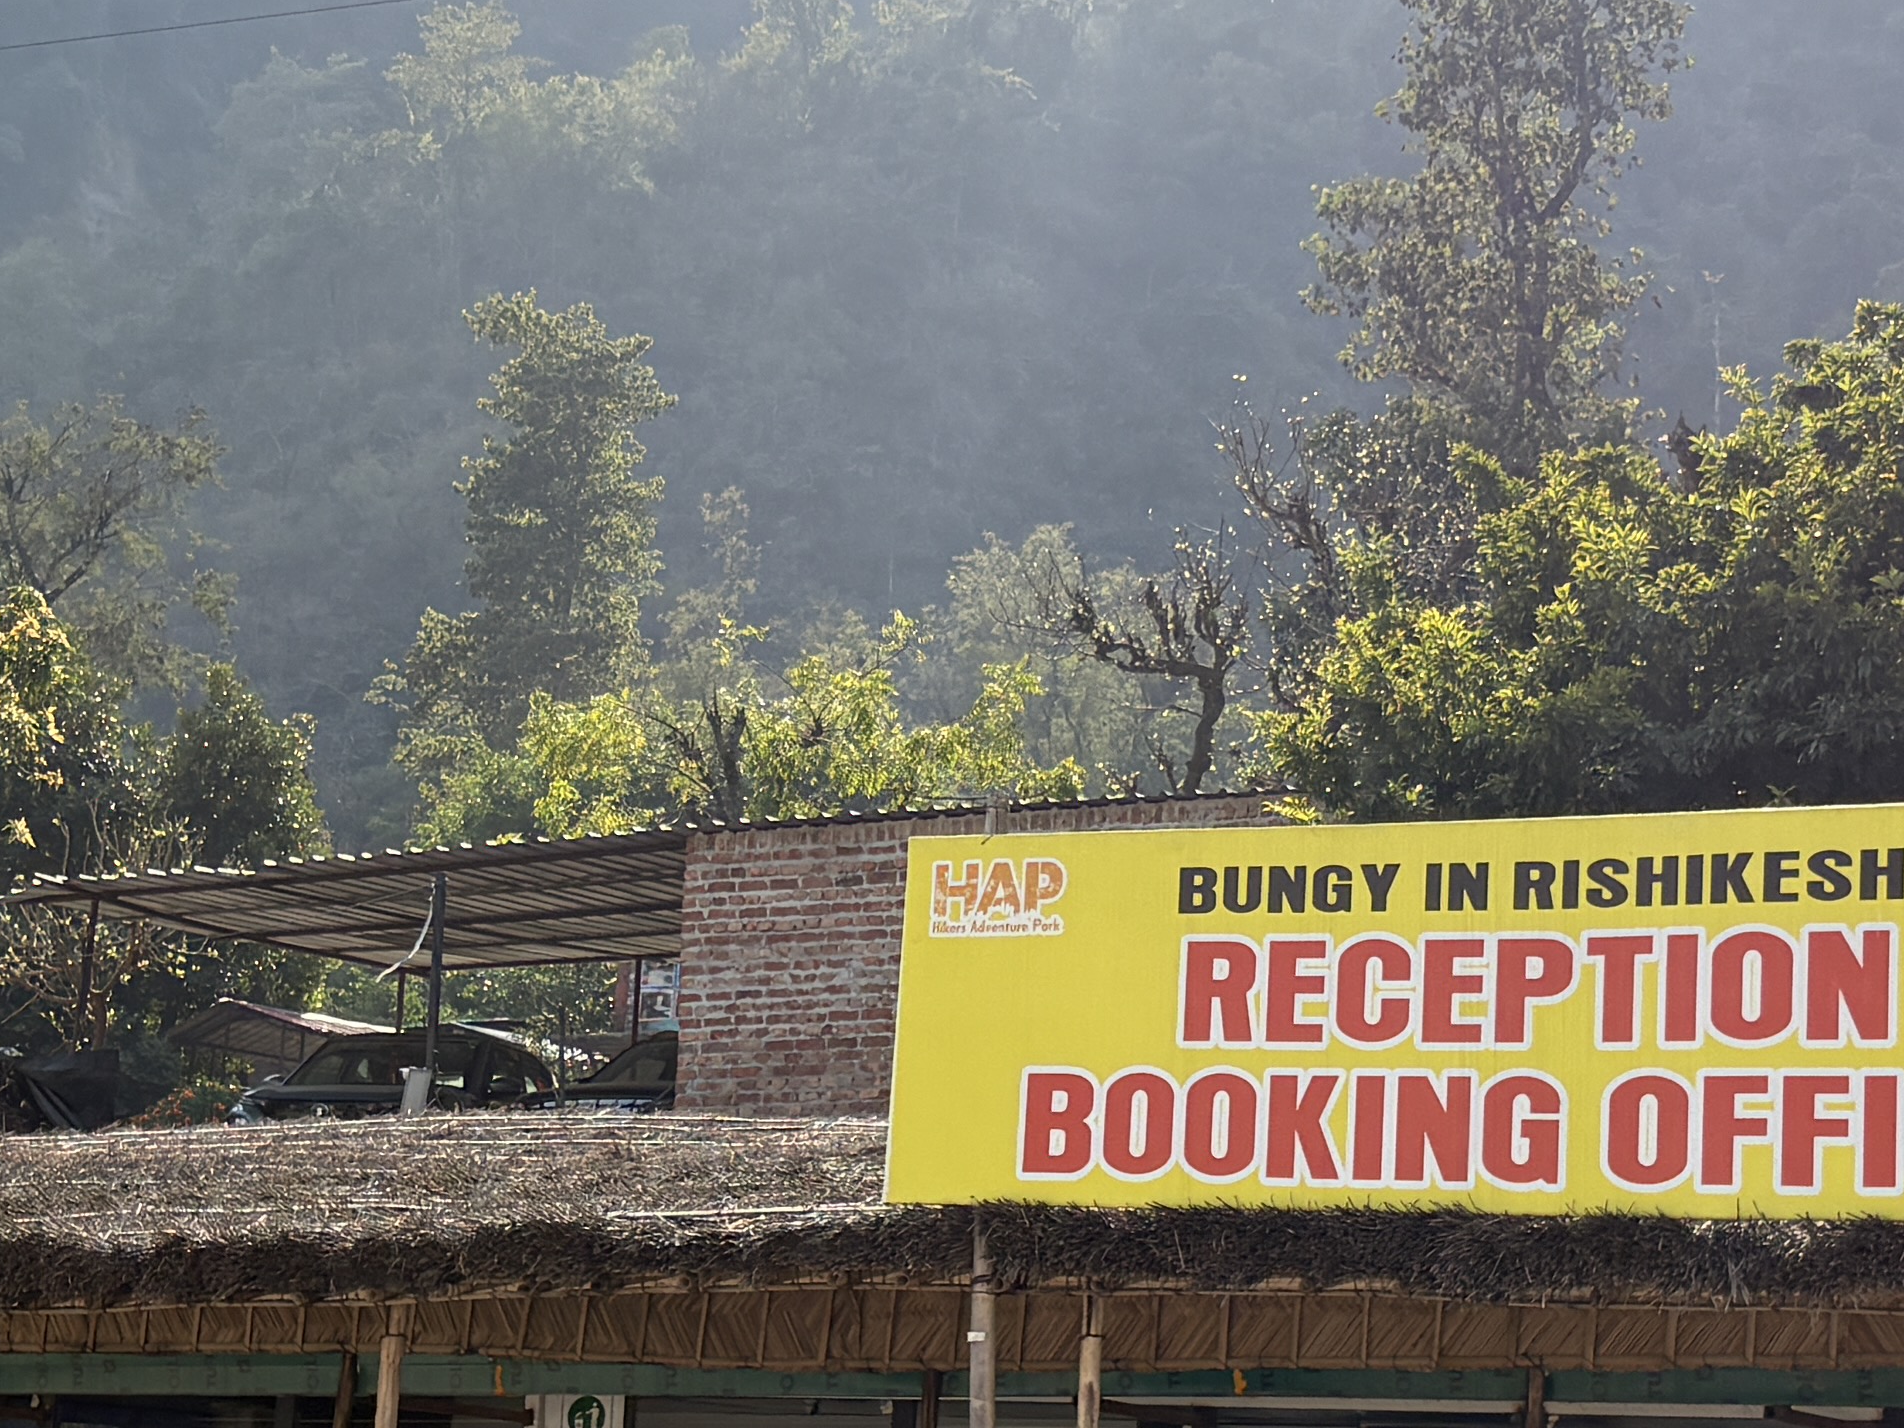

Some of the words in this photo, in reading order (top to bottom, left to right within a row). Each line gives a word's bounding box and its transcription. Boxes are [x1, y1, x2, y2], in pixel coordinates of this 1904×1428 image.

[933, 862, 1065, 918] HAP
[1177, 863, 1392, 914] BUNGY
[1425, 862, 1488, 912] IN
[932, 921, 966, 934] Hikers
[970, 920, 1028, 933] Adventure
[1180, 927, 1895, 1047] RECEPTION
[1021, 1070, 1562, 1186] BOOKING
